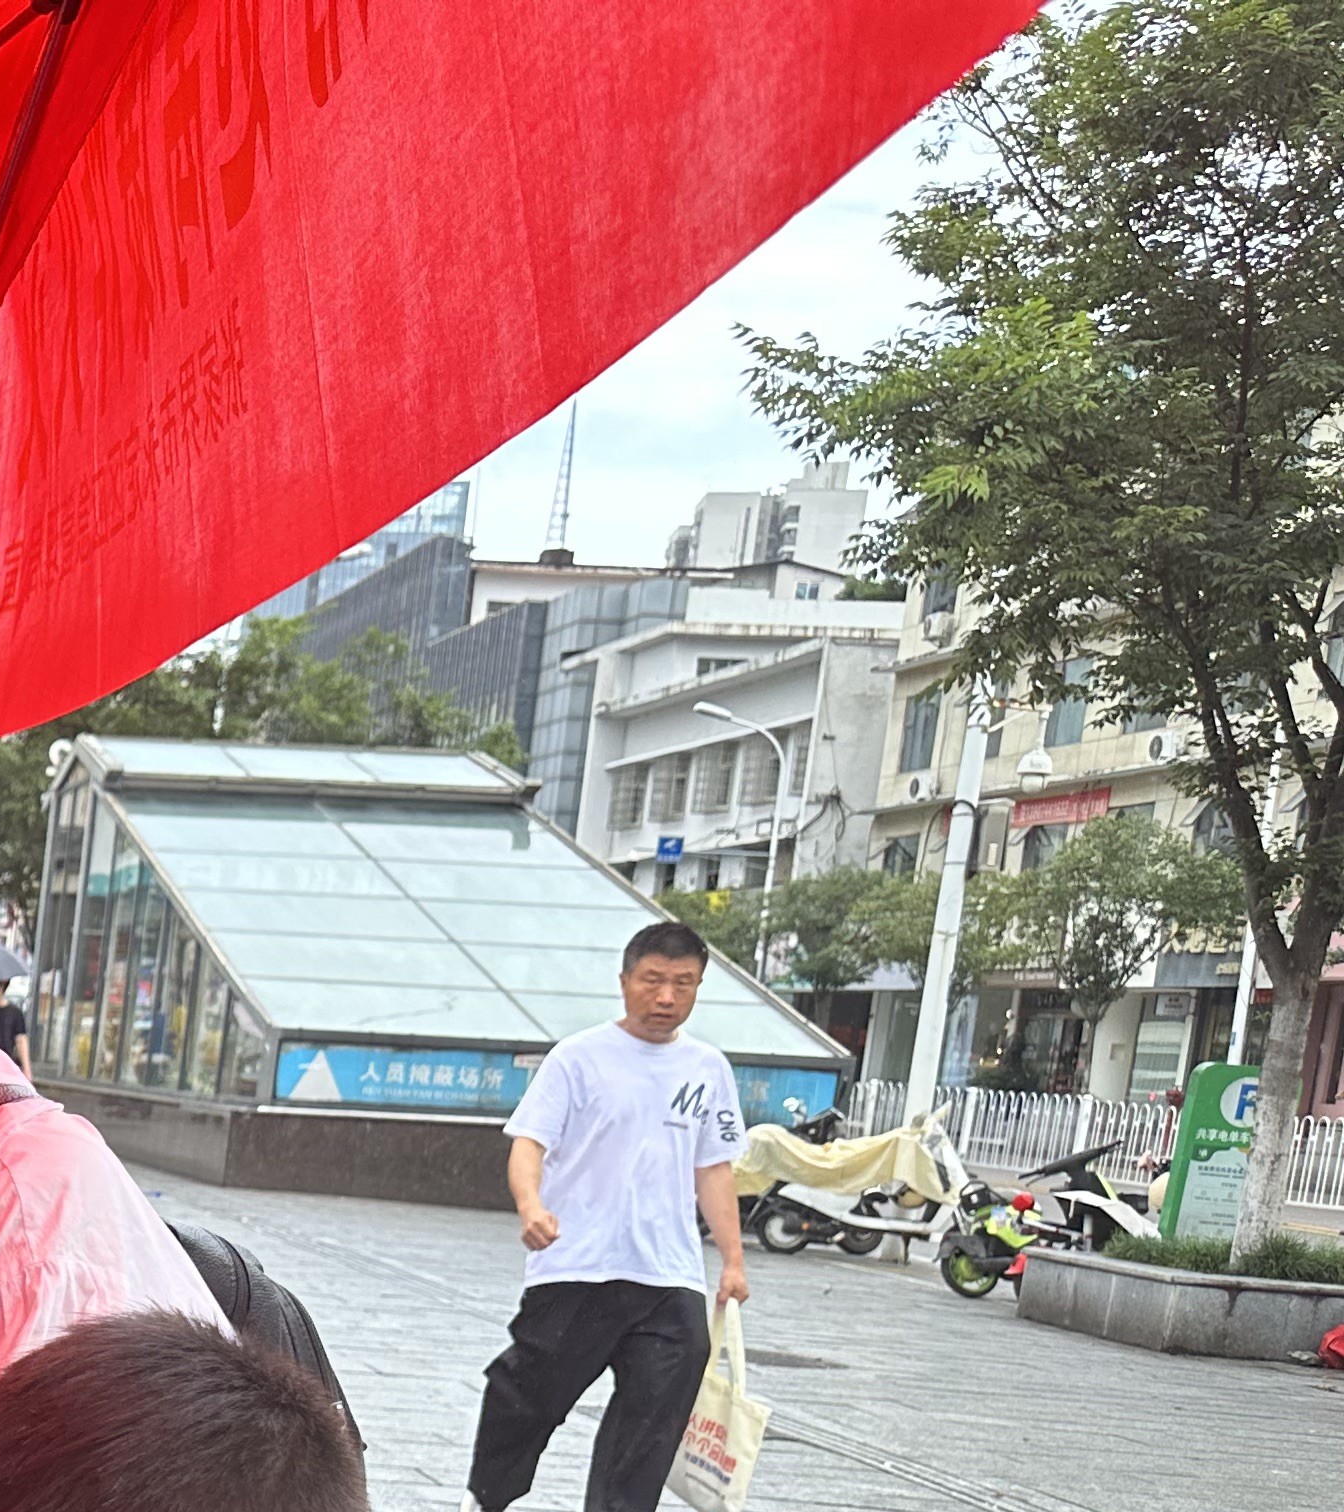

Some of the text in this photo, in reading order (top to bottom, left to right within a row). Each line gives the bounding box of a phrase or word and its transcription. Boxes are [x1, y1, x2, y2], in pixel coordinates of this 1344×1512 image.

[360, 1061, 504, 1090] 人员掩蔽场所
